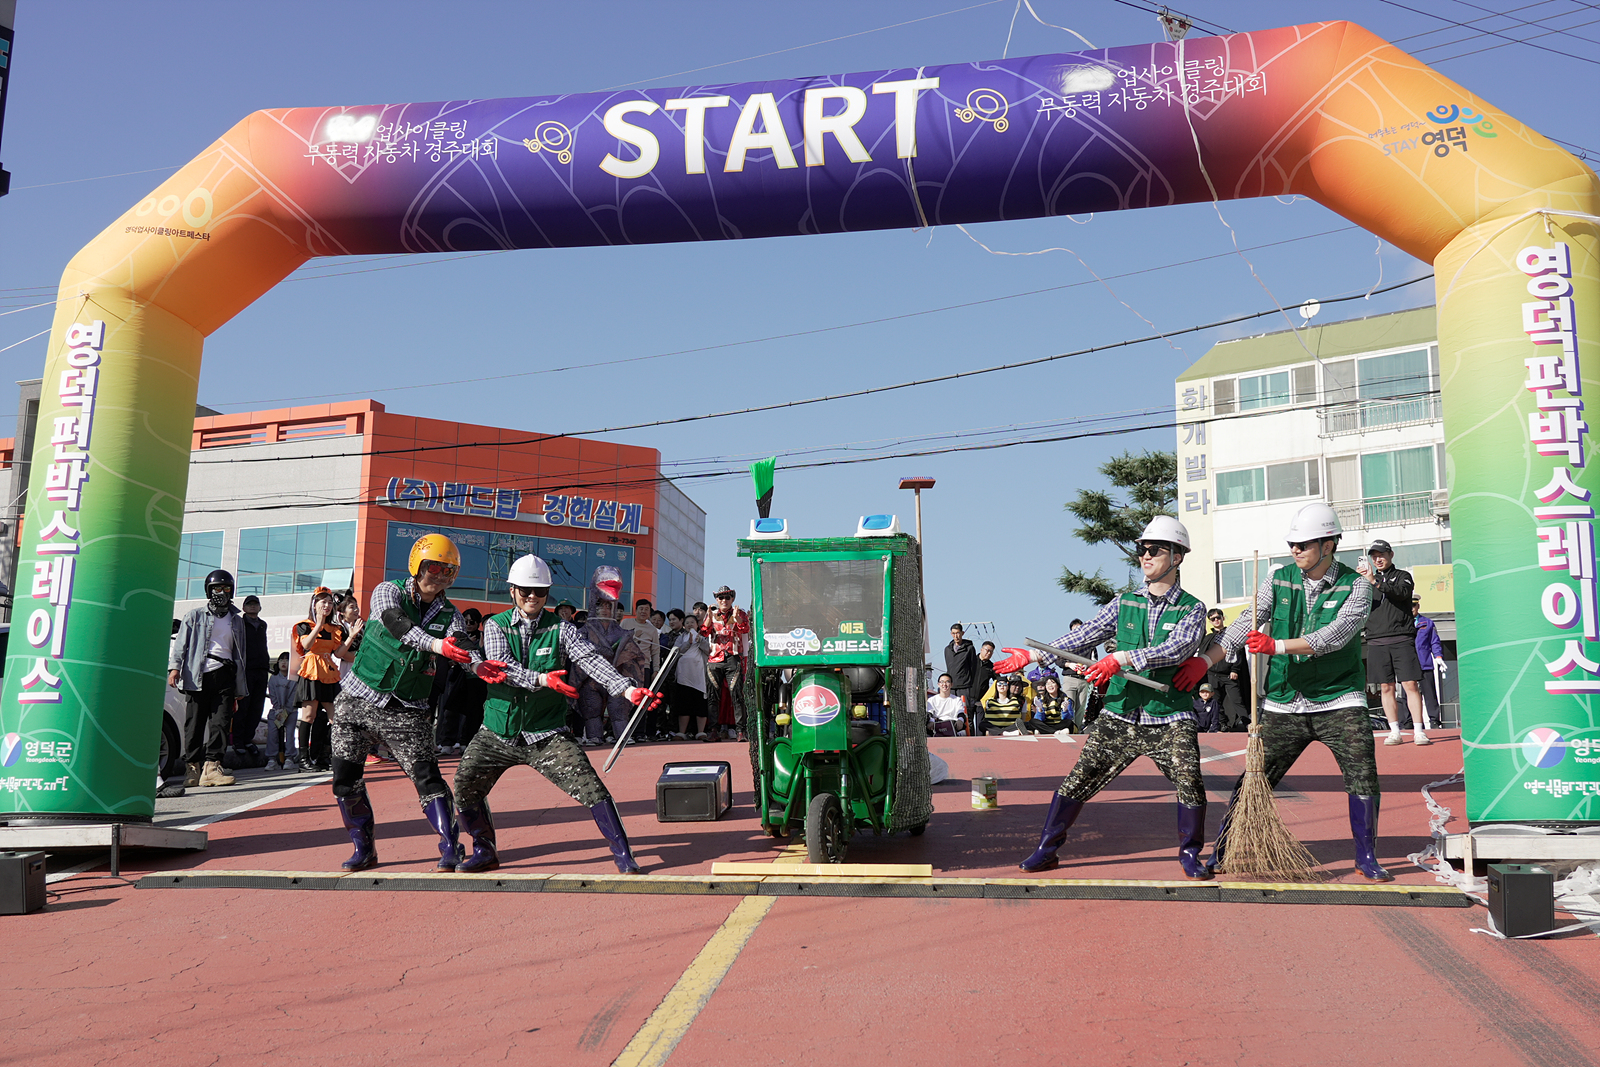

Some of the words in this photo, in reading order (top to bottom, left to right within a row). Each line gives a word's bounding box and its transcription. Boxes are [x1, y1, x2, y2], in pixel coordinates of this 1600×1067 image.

[1117, 56, 1225, 87] 업사이클링
[1036, 92, 1102, 121] 무동력
[1107, 82, 1174, 114] 자동차
[1178, 71, 1268, 104] 경주대회
[375, 119, 468, 143] 업사이클링
[598, 77, 940, 179] START
[1382, 136, 1420, 157] STAY
[1421, 126, 1469, 158] 영덕
[303, 142, 359, 166] 무동력
[363, 140, 420, 164] 자동차
[424, 137, 499, 164] 경주대회
[1181, 384, 1211, 516] 화개빌라
[542, 493, 643, 535] 경현설계
[840, 622, 865, 634] 에코
[786, 641, 806, 656] 영덕
[822, 639, 883, 653] 스피드스터
[25, 741, 72, 757] 영덕군
